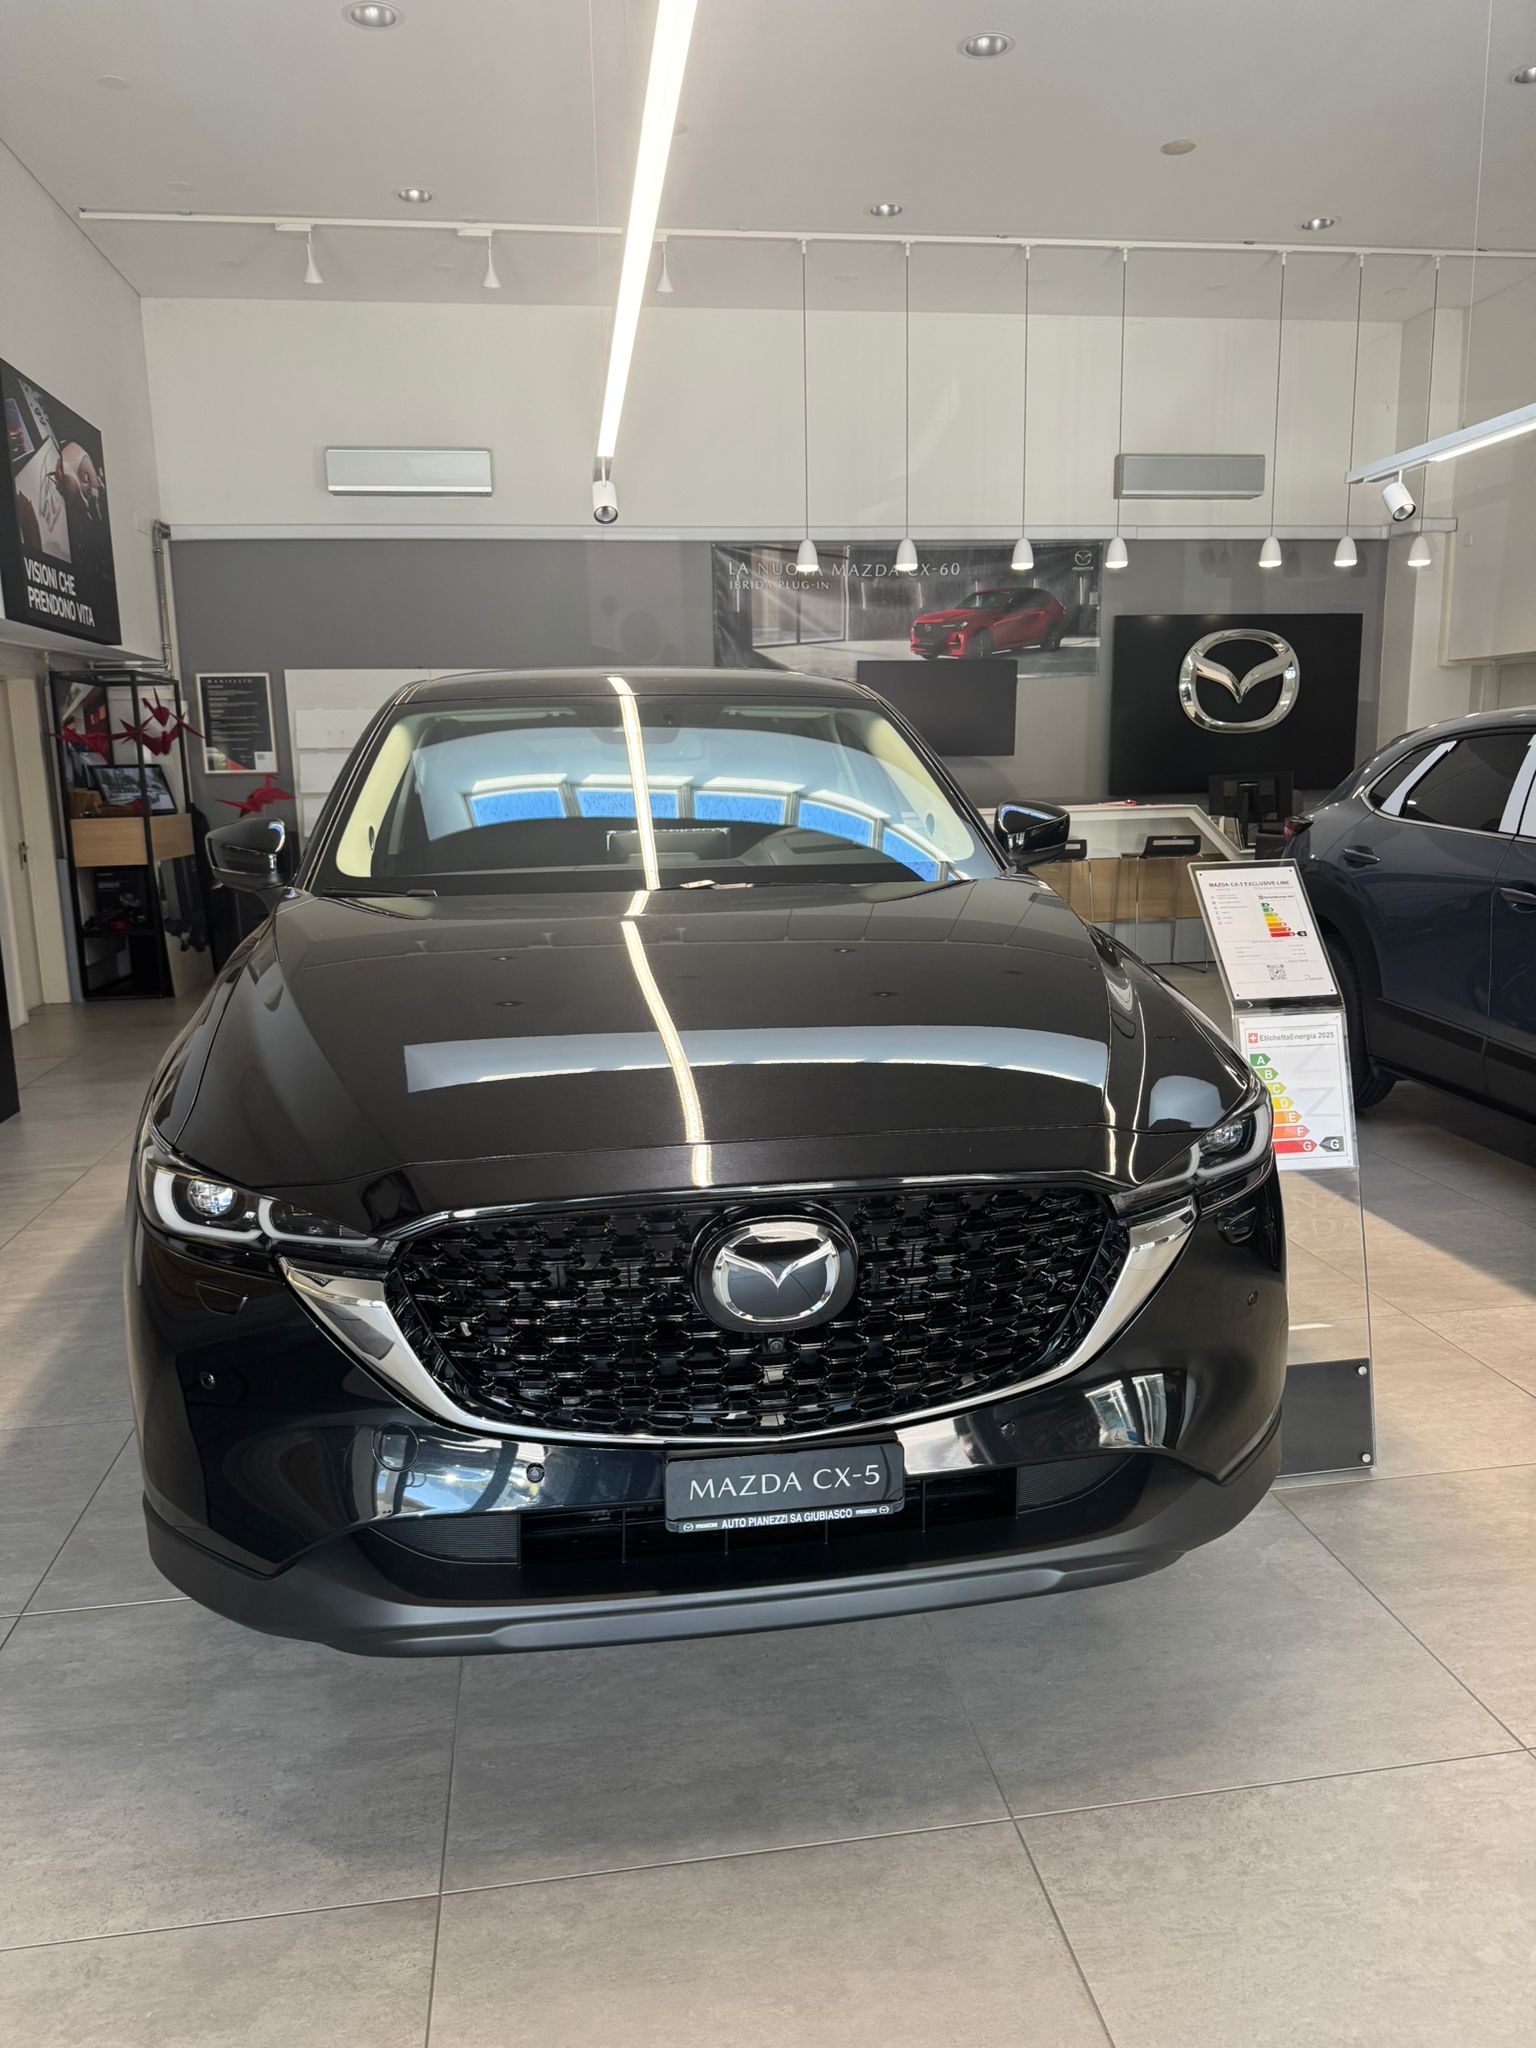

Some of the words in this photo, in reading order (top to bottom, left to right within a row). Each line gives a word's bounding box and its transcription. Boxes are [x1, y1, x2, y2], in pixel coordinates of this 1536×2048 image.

[729, 562, 749, 576] LA
[758, 562, 823, 577] NUOA
[831, 563, 899, 577] MAZDA
[24, 556, 58, 590] VISIONI
[59, 570, 77, 596] CHE
[729, 580, 773, 590] IBRIDA
[778, 581, 829, 590] PLUG-IN
[27, 585, 76, 621] PRENDONO
[76, 602, 95, 627] VITA
[1259, 1033, 1316, 1042] EtichettaEnergia
[1257, 1055, 1266, 1065] A
[1264, 1069, 1273, 1079] B
[1272, 1084, 1281, 1093] C
[1280, 1098, 1289, 1108] D
[1288, 1113, 1297, 1122] E
[1296, 1127, 1304, 1136] F
[1302, 1141, 1312, 1151] G
[1330, 1139, 1340, 1149] G
[689, 1471, 803, 1500] MAZDA
[812, 1464, 881, 1489] CX-5
[721, 1517, 747, 1529] AUTO
[748, 1514, 788, 1527] PIANEZZI
[789, 1514, 803, 1523] SA
[803, 1508, 853, 1522] GIUBIASCO
